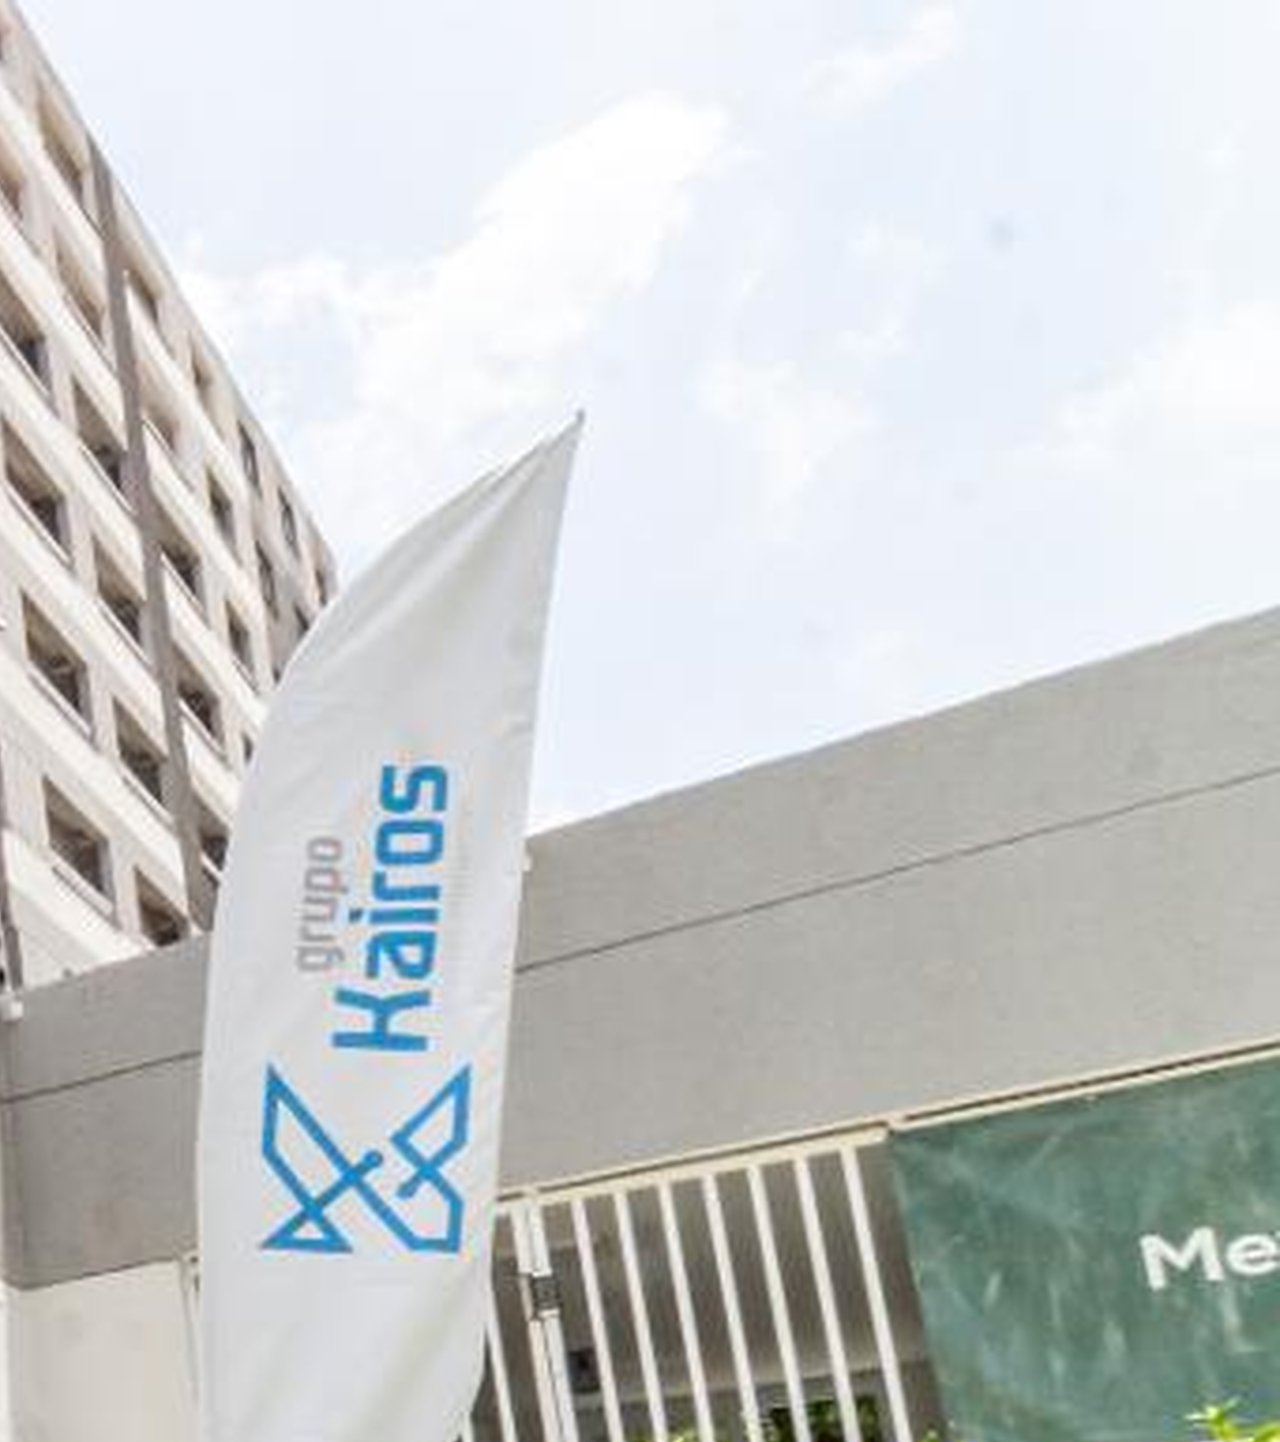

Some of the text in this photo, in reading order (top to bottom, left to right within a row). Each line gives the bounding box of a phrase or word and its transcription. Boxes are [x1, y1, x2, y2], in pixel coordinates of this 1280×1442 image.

[296, 836, 347, 972] grupo
[332, 764, 448, 1051] Kairos
[1140, 1226, 1280, 1290] Me
